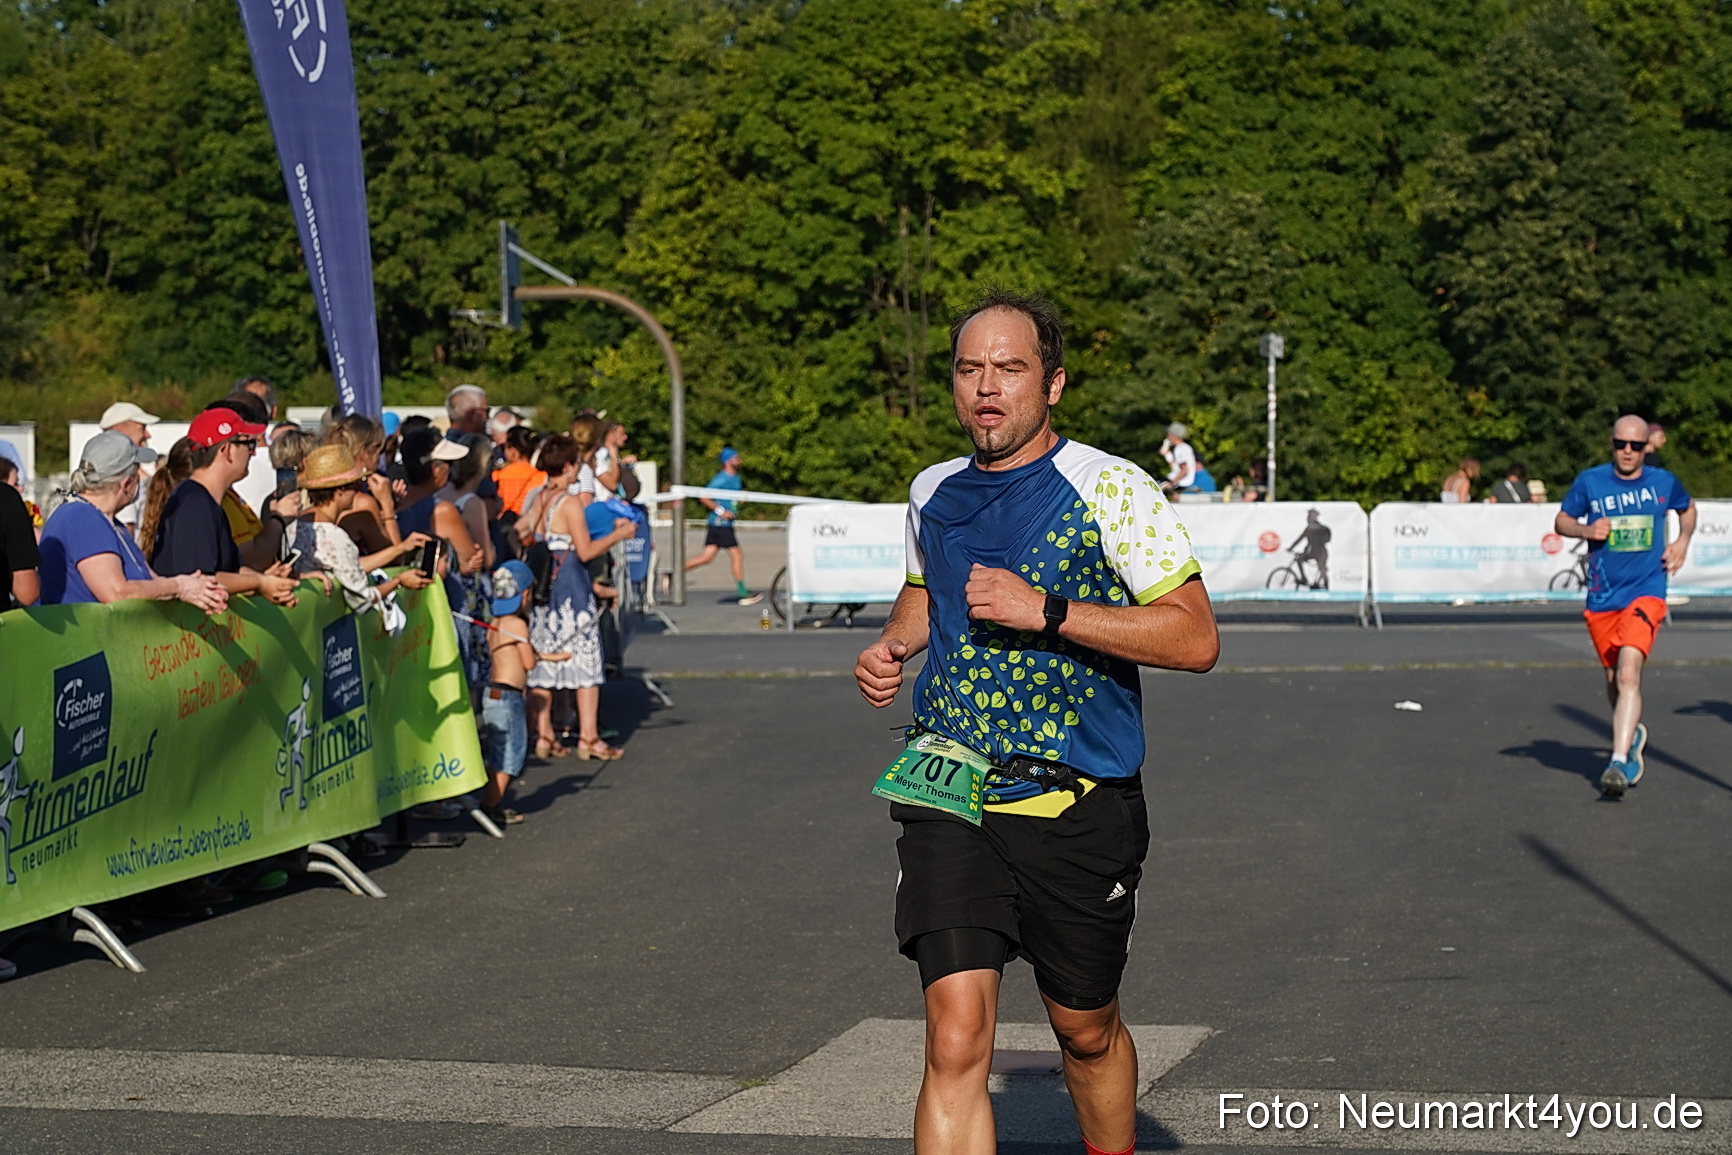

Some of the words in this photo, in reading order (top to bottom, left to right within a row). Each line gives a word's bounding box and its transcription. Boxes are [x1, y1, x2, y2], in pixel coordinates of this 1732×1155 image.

[143, 623, 201, 681] Gesunde
[64, 691, 105, 721] Fischer
[22, 728, 158, 846] firmenlauf
[885, 757, 908, 781] RUN
[908, 752, 963, 787] 707
[893, 774, 923, 792] Meyer
[925, 784, 967, 804] Thomas
[969, 773, 981, 812] 2022
[22, 827, 79, 874] neumarkt
